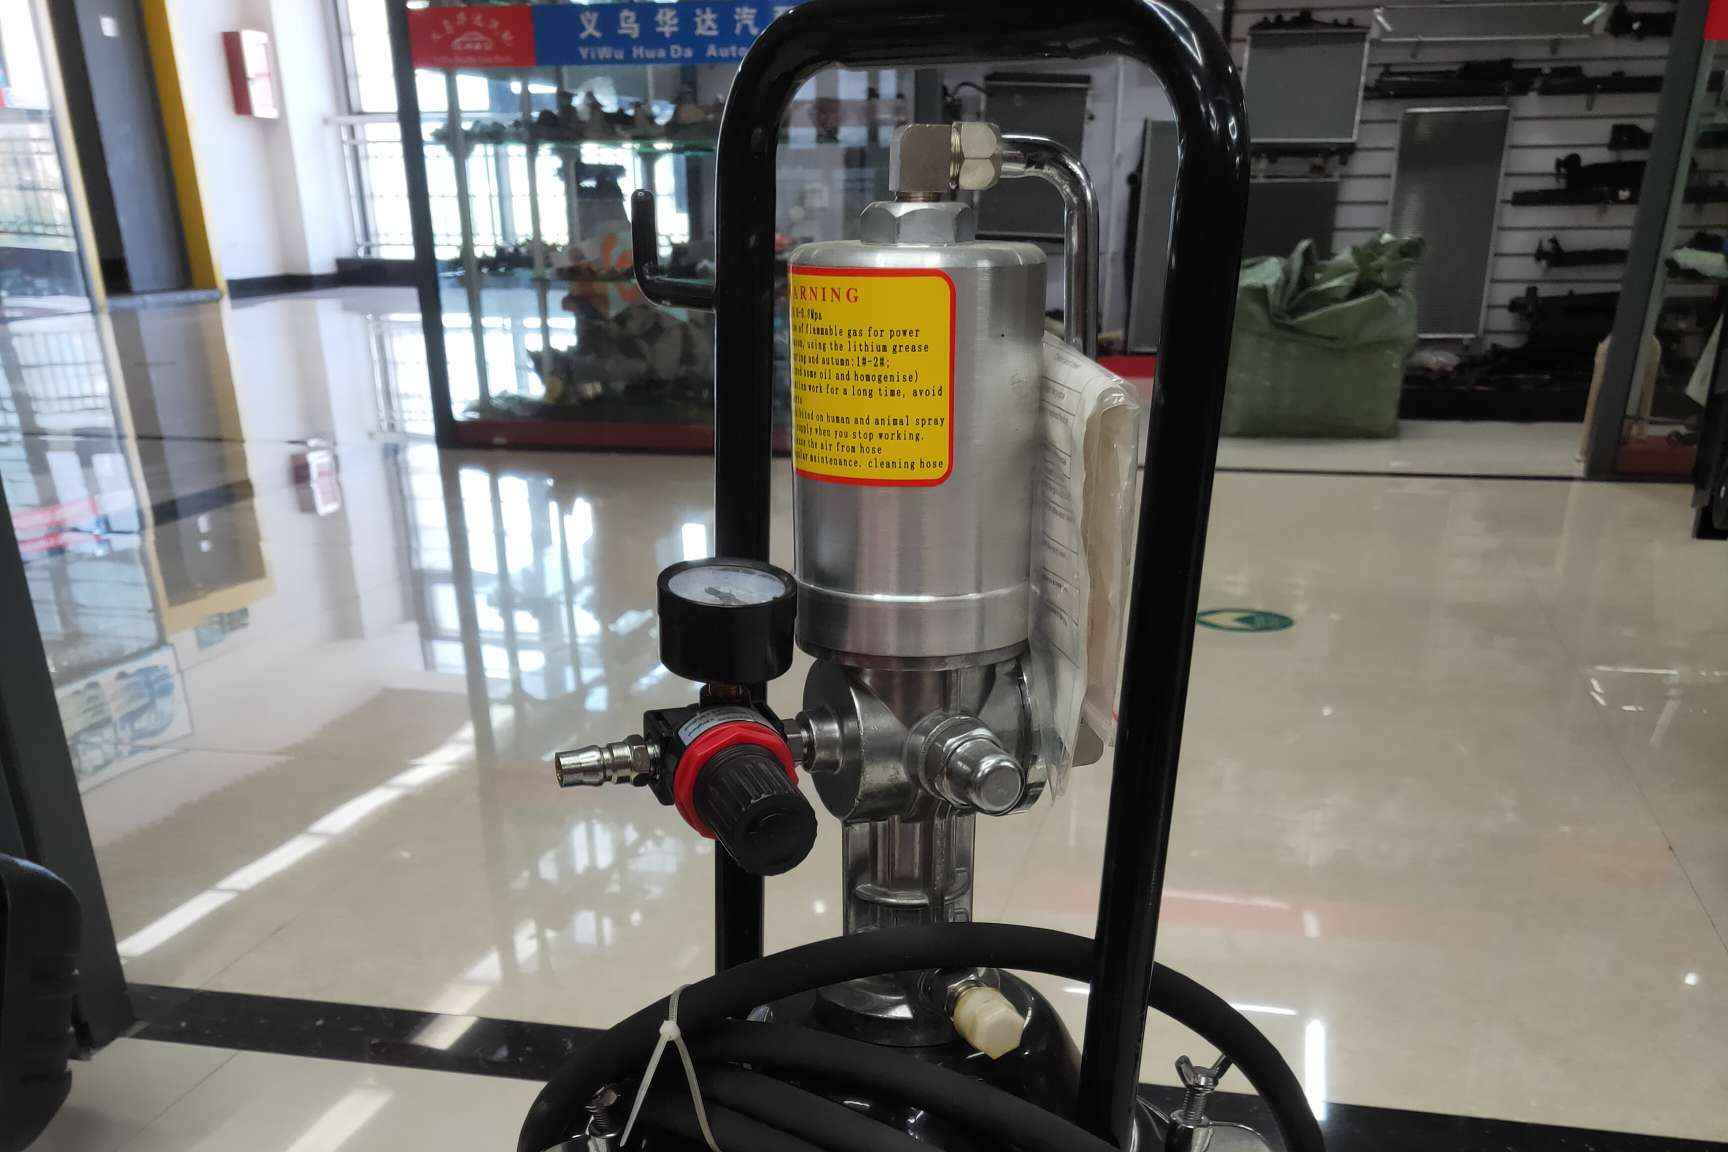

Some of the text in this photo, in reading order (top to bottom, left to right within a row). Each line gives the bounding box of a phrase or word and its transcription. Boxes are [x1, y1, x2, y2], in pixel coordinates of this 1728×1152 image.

[579, 6, 792, 39] 义乌华达汽
[579, 46, 624, 60] YiWu
[632, 45, 665, 59] Hua
[669, 44, 693, 58] Da
[793, 286, 859, 303] ARNING
[847, 328, 863, 339] gas
[867, 326, 885, 337] for
[889, 329, 920, 340] power
[830, 341, 843, 352] the
[848, 340, 888, 352] lithium
[892, 344, 929, 355] grease
[819, 369, 832, 380] oil
[836, 370, 850, 381] and
[827, 384, 839, 395] for
[852, 386, 874, 399] long
[878, 386, 905, 399] time,
[912, 385, 943, 397] avoid
[826, 412, 851, 425] human
[854, 415, 870, 426] and
[874, 415, 910, 427] animal
[915, 417, 945, 428] spray
[815, 425, 831, 438] when
[834, 429, 849, 439] you
[852, 430, 874, 442] stop
[820, 440, 833, 452] air
[836, 441, 856, 454] from
[859, 442, 882, 455] hose
[867, 457, 916, 471] cleaning
[919, 458, 944, 469] hose
